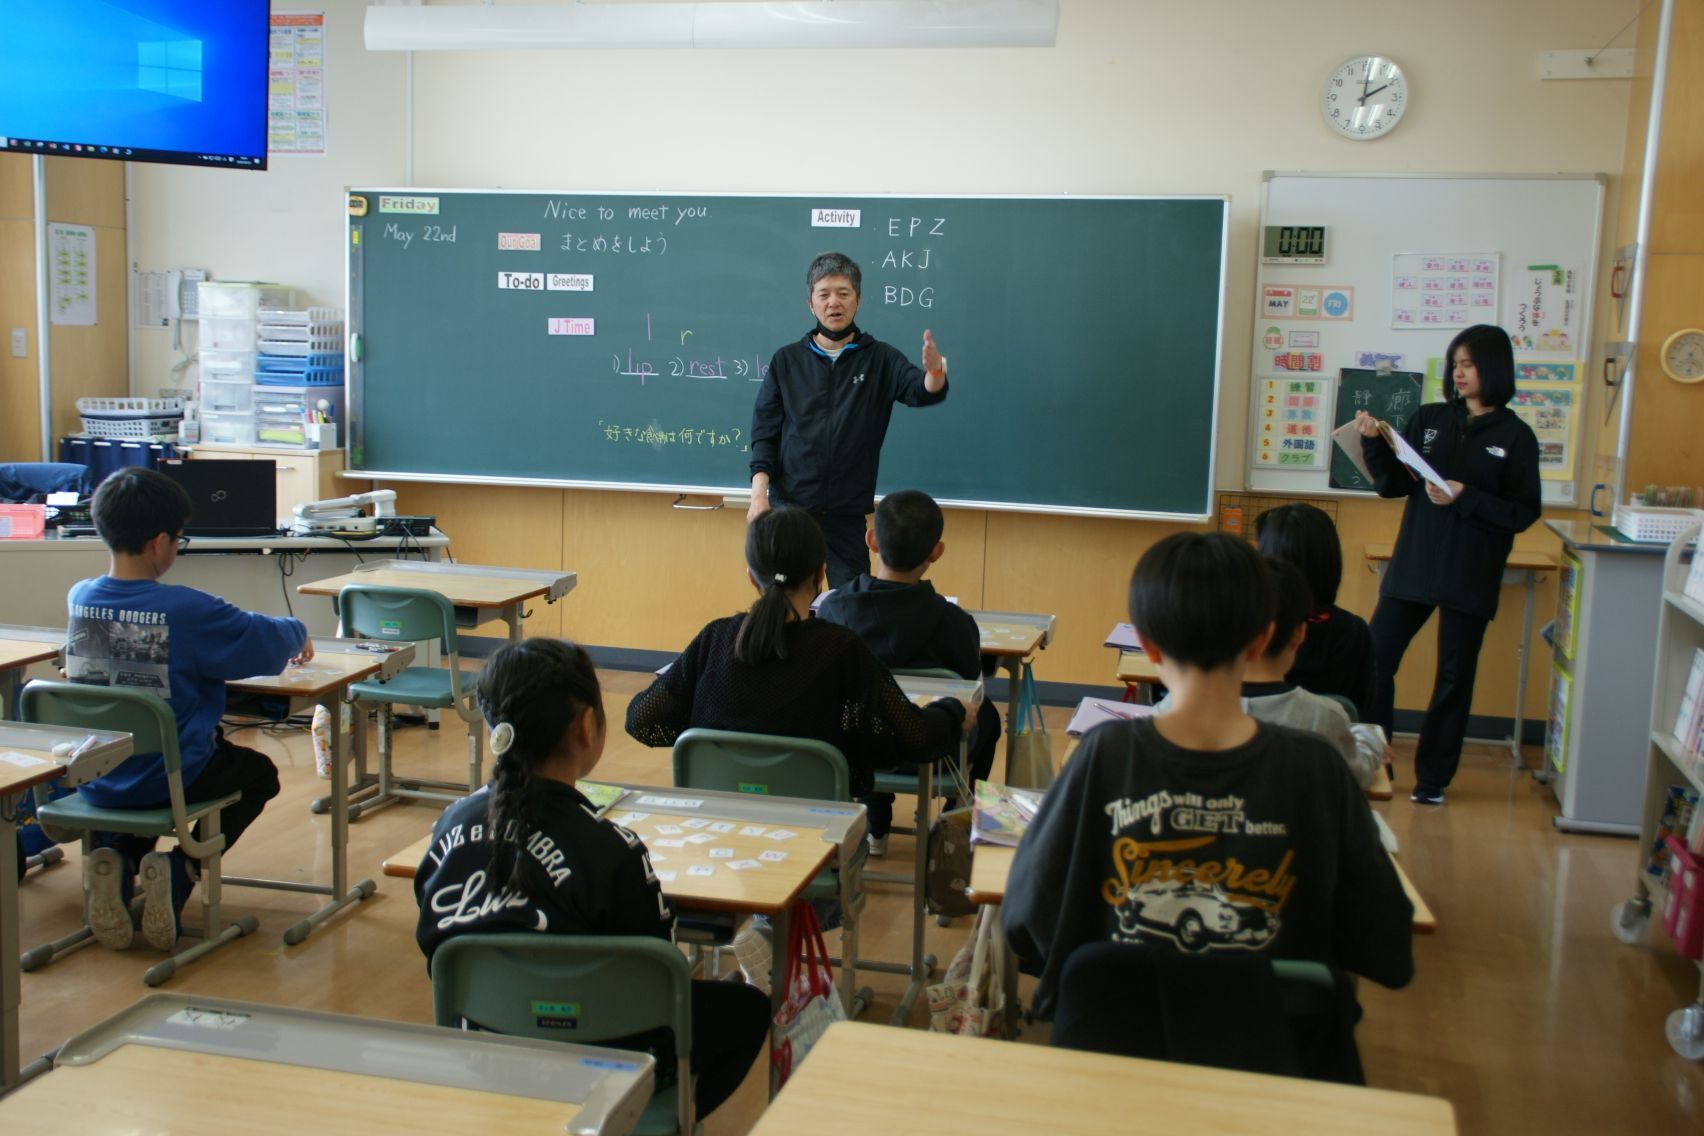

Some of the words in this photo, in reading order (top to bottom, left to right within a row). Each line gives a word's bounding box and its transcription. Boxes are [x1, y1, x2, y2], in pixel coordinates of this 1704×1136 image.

[1335, 79, 1343, 88] 10
[1330, 94, 1337, 102] 9
[1391, 93, 1398, 102] 3
[1333, 108, 1340, 118] 8
[381, 198, 436, 213] Friday
[544, 199, 587, 219] Nice
[597, 205, 614, 220] to
[628, 204, 669, 220] meet
[817, 210, 856, 226] Activity
[383, 222, 415, 249] May
[423, 225, 457, 243] 22nd
[501, 235, 518, 248] Our
[519, 236, 538, 249] Goal
[560, 231, 667, 255] まとめをしよう
[1279, 227, 1325, 254] 0:00
[504, 273, 540, 289] To-do
[552, 275, 590, 290] Greetings
[1268, 300, 1289, 308] MAY
[554, 320, 561, 333] J
[564, 320, 591, 334] Time
[680, 329, 693, 345] r
[1274, 352, 1322, 371] 時間割
[1268, 381, 1274, 389] 1
[1267, 395, 1274, 403] 2
[1263, 439, 1269, 447] 5
[1283, 439, 1315, 450] 外国語
[1280, 453, 1313, 462] クラブ
[119, 609, 167, 625] DODGERS
[1104, 790, 1172, 835] Things
[1173, 792, 1203, 807] will
[1206, 794, 1244, 810] only
[1170, 808, 1245, 834] GET
[1245, 820, 1287, 835] better.
[1102, 836, 1296, 914] Sincerely
